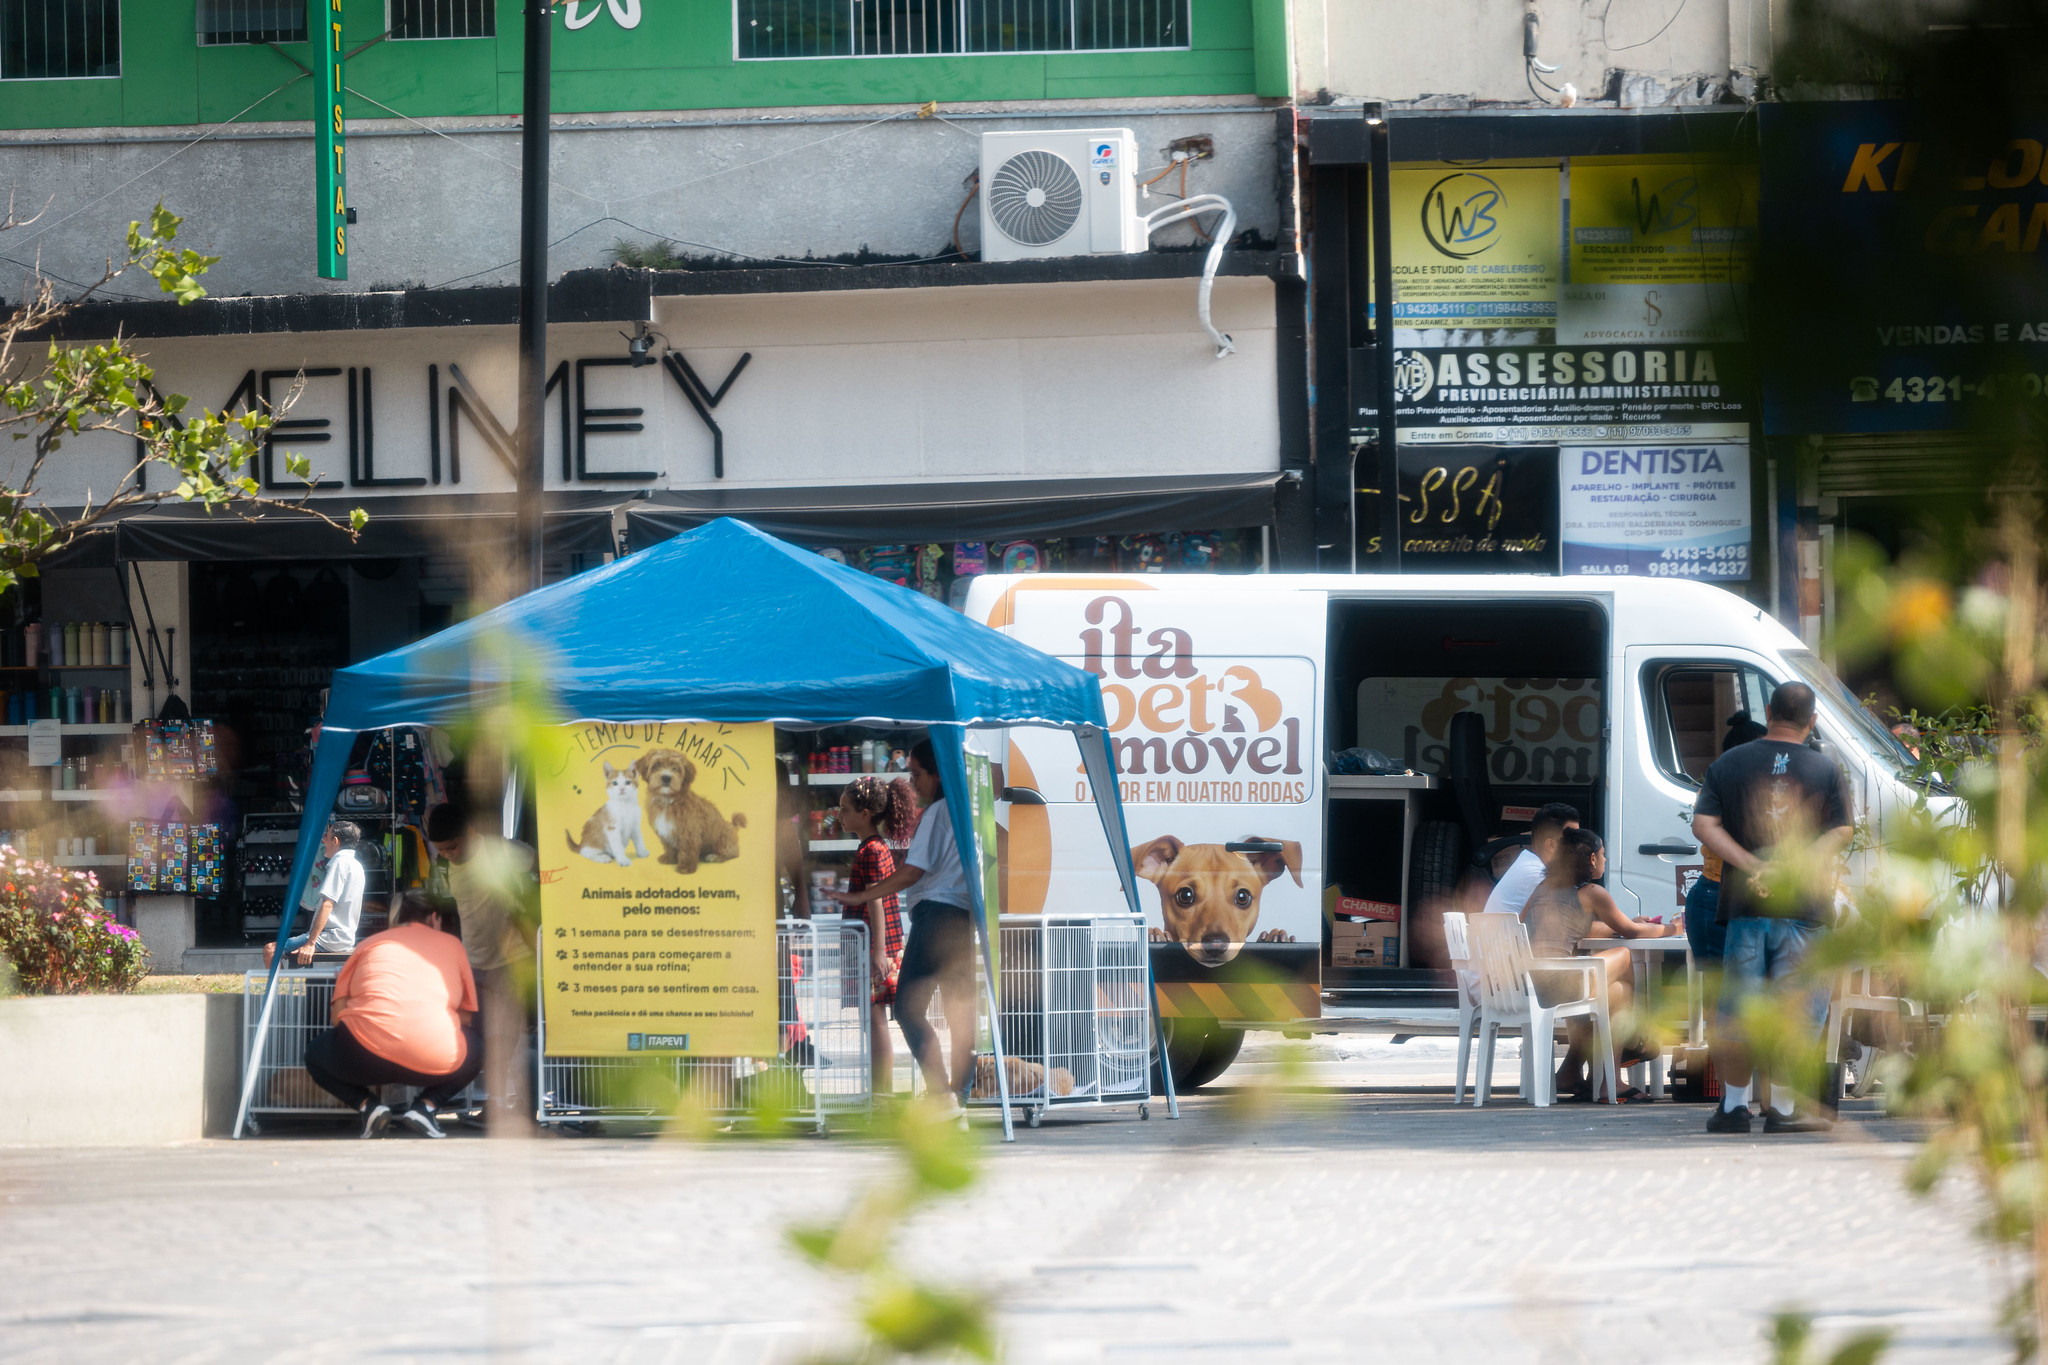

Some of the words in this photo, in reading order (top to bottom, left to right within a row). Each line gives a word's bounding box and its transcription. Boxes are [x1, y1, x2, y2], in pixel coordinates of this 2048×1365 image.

[1422, 266, 1427, 274] E
[1430, 265, 1464, 274] STUDIO
[1466, 265, 1478, 273] DE
[1877, 324, 1984, 346] VENDAS
[1994, 323, 2009, 341] E
[1437, 350, 1718, 387] ASSESSORIA
[1438, 385, 1577, 402] PREVIDENCIÁRIA
[1578, 384, 1721, 399] ADMINISTRATIVO
[1416, 406, 1475, 415] Previdenciário
[1482, 405, 1546, 415] Aposentadorias
[1622, 403, 1652, 411] Pensão
[1654, 404, 1668, 413] por
[1670, 403, 1694, 411] morte
[1701, 402, 1720, 410] BPC
[1722, 402, 1742, 410] Loas
[1513, 413, 1571, 424] Aposentadoria
[1573, 415, 1588, 423] por
[1622, 412, 1661, 421] Recursos
[1411, 431, 1436, 440] Entre
[1456, 431, 1493, 440] Contato
[1607, 426, 1628, 439] (11)
[1581, 449, 1724, 475] DENTISTA
[1570, 483, 1622, 492] APARELHO
[1631, 482, 1680, 491] IMPLANTE
[1693, 479, 1736, 490] PRÓTESE
[1590, 492, 1660, 504] RESTAURAÇÃO
[1669, 493, 1717, 502] CIRURGIA
[1664, 509, 1697, 517] TÉCNICA
[1404, 534, 1473, 553] conceito
[1476, 532, 1497, 552] de
[1661, 545, 1747, 560] 4143-5498
[1580, 565, 1611, 575] SALA
[1613, 564, 1629, 574] 03
[1648, 560, 1747, 576] 98344-4237
[1079, 596, 1198, 679] ita
[674, 727, 723, 768] AMAR
[1109, 717, 1303, 775] móvel
[1075, 781, 1086, 802] O
[1146, 781, 1171, 802] EM
[1176, 781, 1243, 803] QUATRO
[1247, 781, 1305, 803] RODAS
[581, 887, 632, 900] Animais
[635, 886, 696, 899] adotados
[698, 886, 740, 901] levam,
[622, 903, 652, 918] pelo
[654, 904, 701, 916] menos:
[1342, 899, 1396, 915] CHAMEX
[580, 929, 621, 938] semana
[624, 929, 648, 940] para
[651, 929, 664, 938] se
[666, 927, 756, 939] desestressarem;
[572, 950, 579, 960] 3
[582, 951, 629, 960] semanas
[632, 951, 656, 961] para
[658, 950, 722, 961] começarem
[725, 951, 732, 959] a
[572, 961, 623, 971] entender
[625, 963, 632, 971] a
[634, 963, 653, 971] sua
[656, 961, 691, 973] rotina;
[573, 983, 580, 993] 3
[583, 984, 618, 993] meses
[620, 984, 645, 996] para
[647, 985, 660, 994] se
[662, 983, 710, 993] sentirem
[712, 984, 729, 993] em
[731, 984, 760, 994] casa.
[571, 1009, 593, 1017] Tenha
[594, 1009, 631, 1018] paciência
[665, 1009, 692, 1017] chance
[648, 1036, 683, 1047] ITAPEVI
